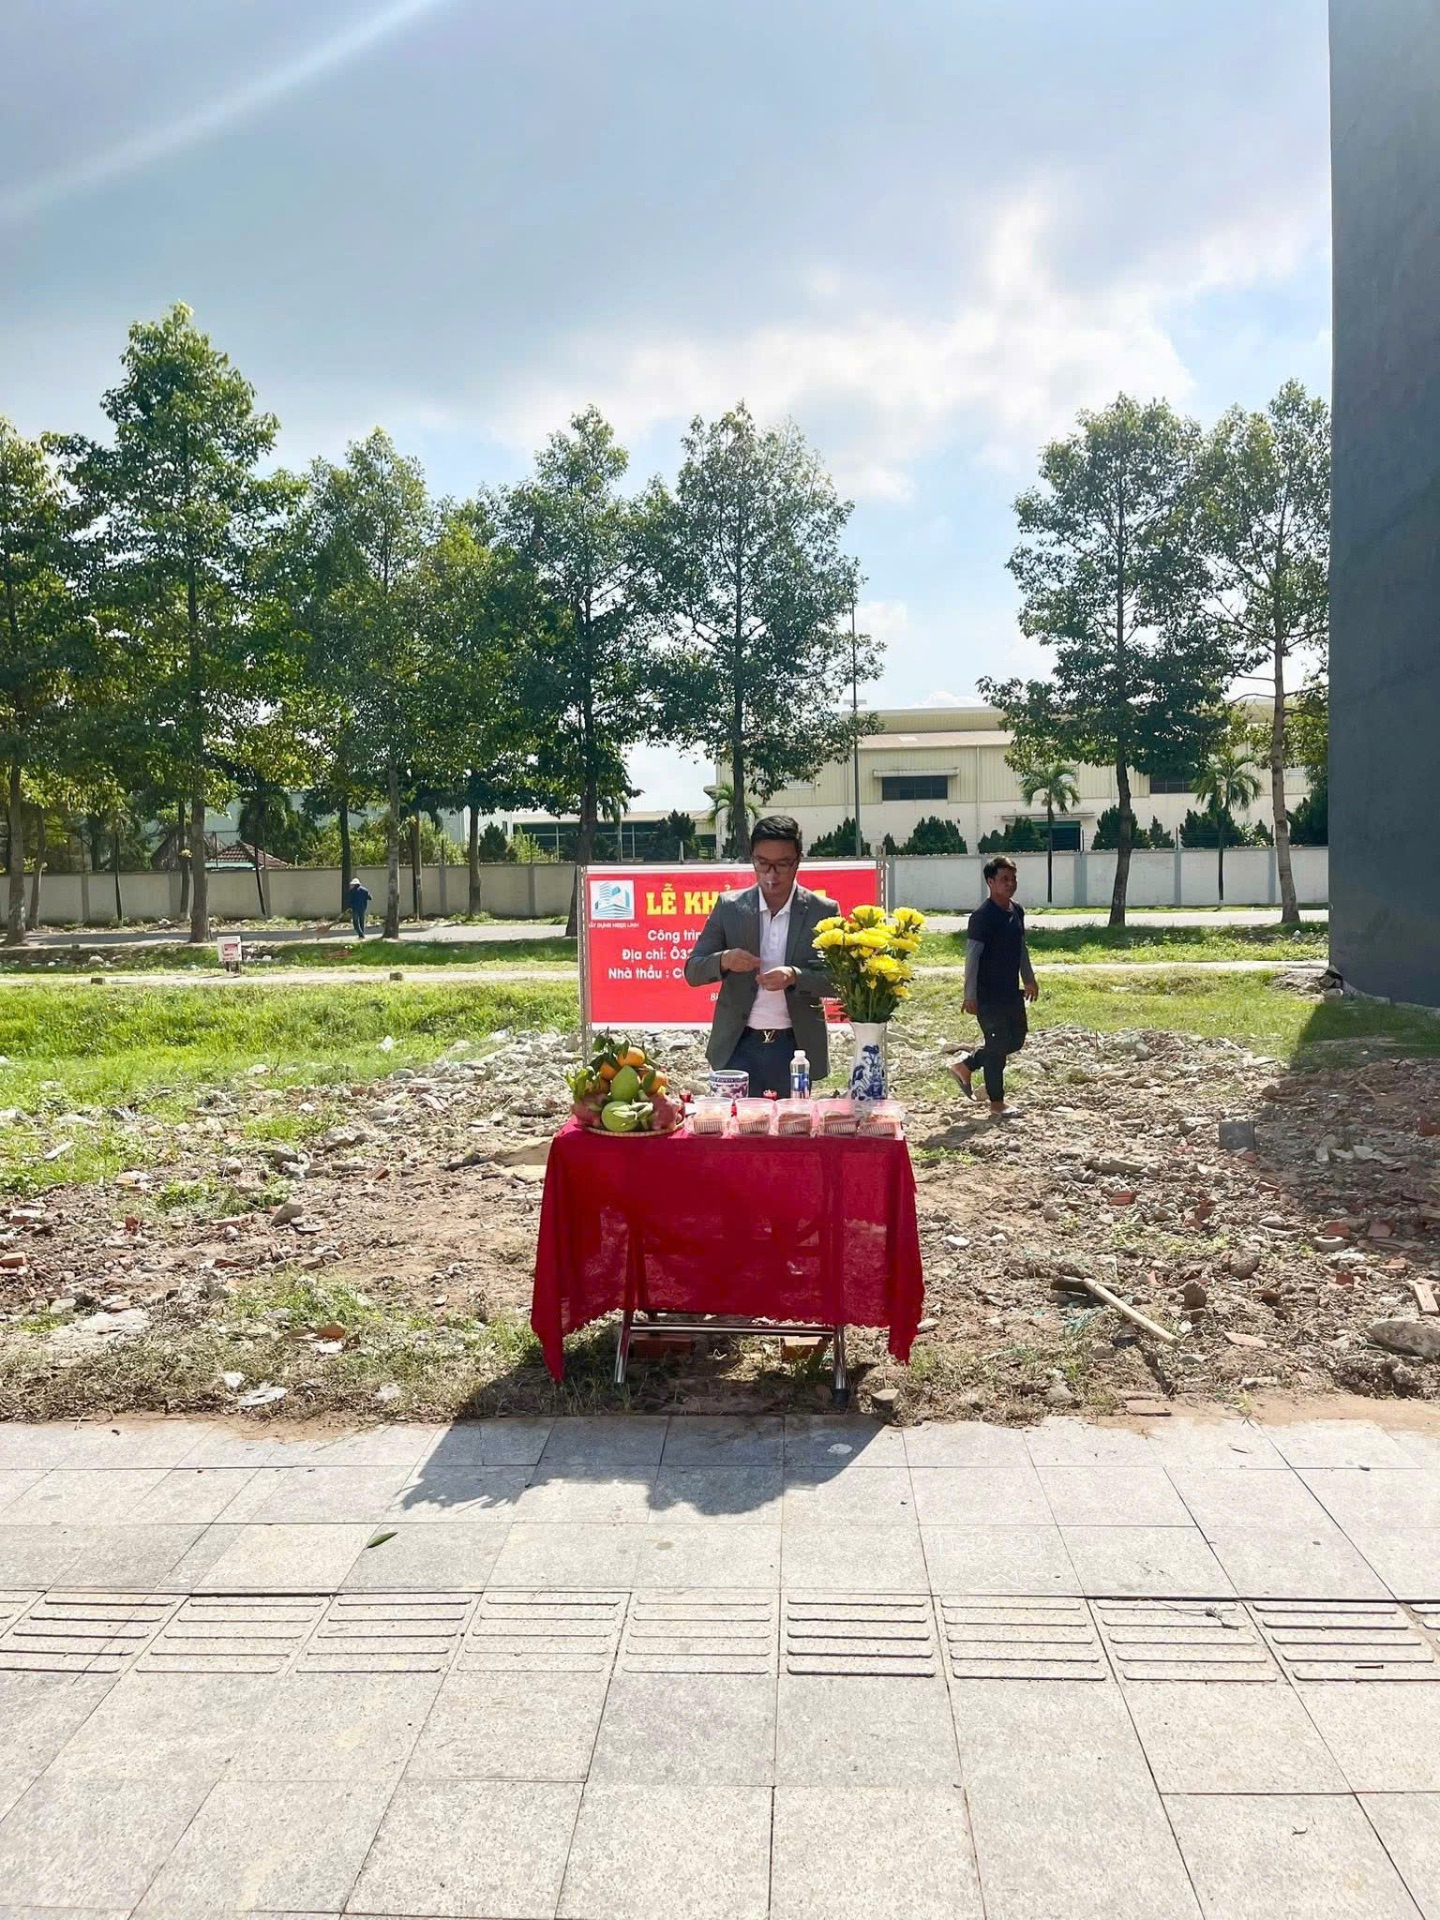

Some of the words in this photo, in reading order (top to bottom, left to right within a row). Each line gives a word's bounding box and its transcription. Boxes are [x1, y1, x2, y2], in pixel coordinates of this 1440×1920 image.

[646, 882, 677, 916] LỄ
[647, 929, 681, 944] Công
[622, 948, 642, 963] Địa
[645, 947, 667, 960] chỉ:
[608, 967, 632, 979] Nhà
[636, 964, 663, 979] thầu
